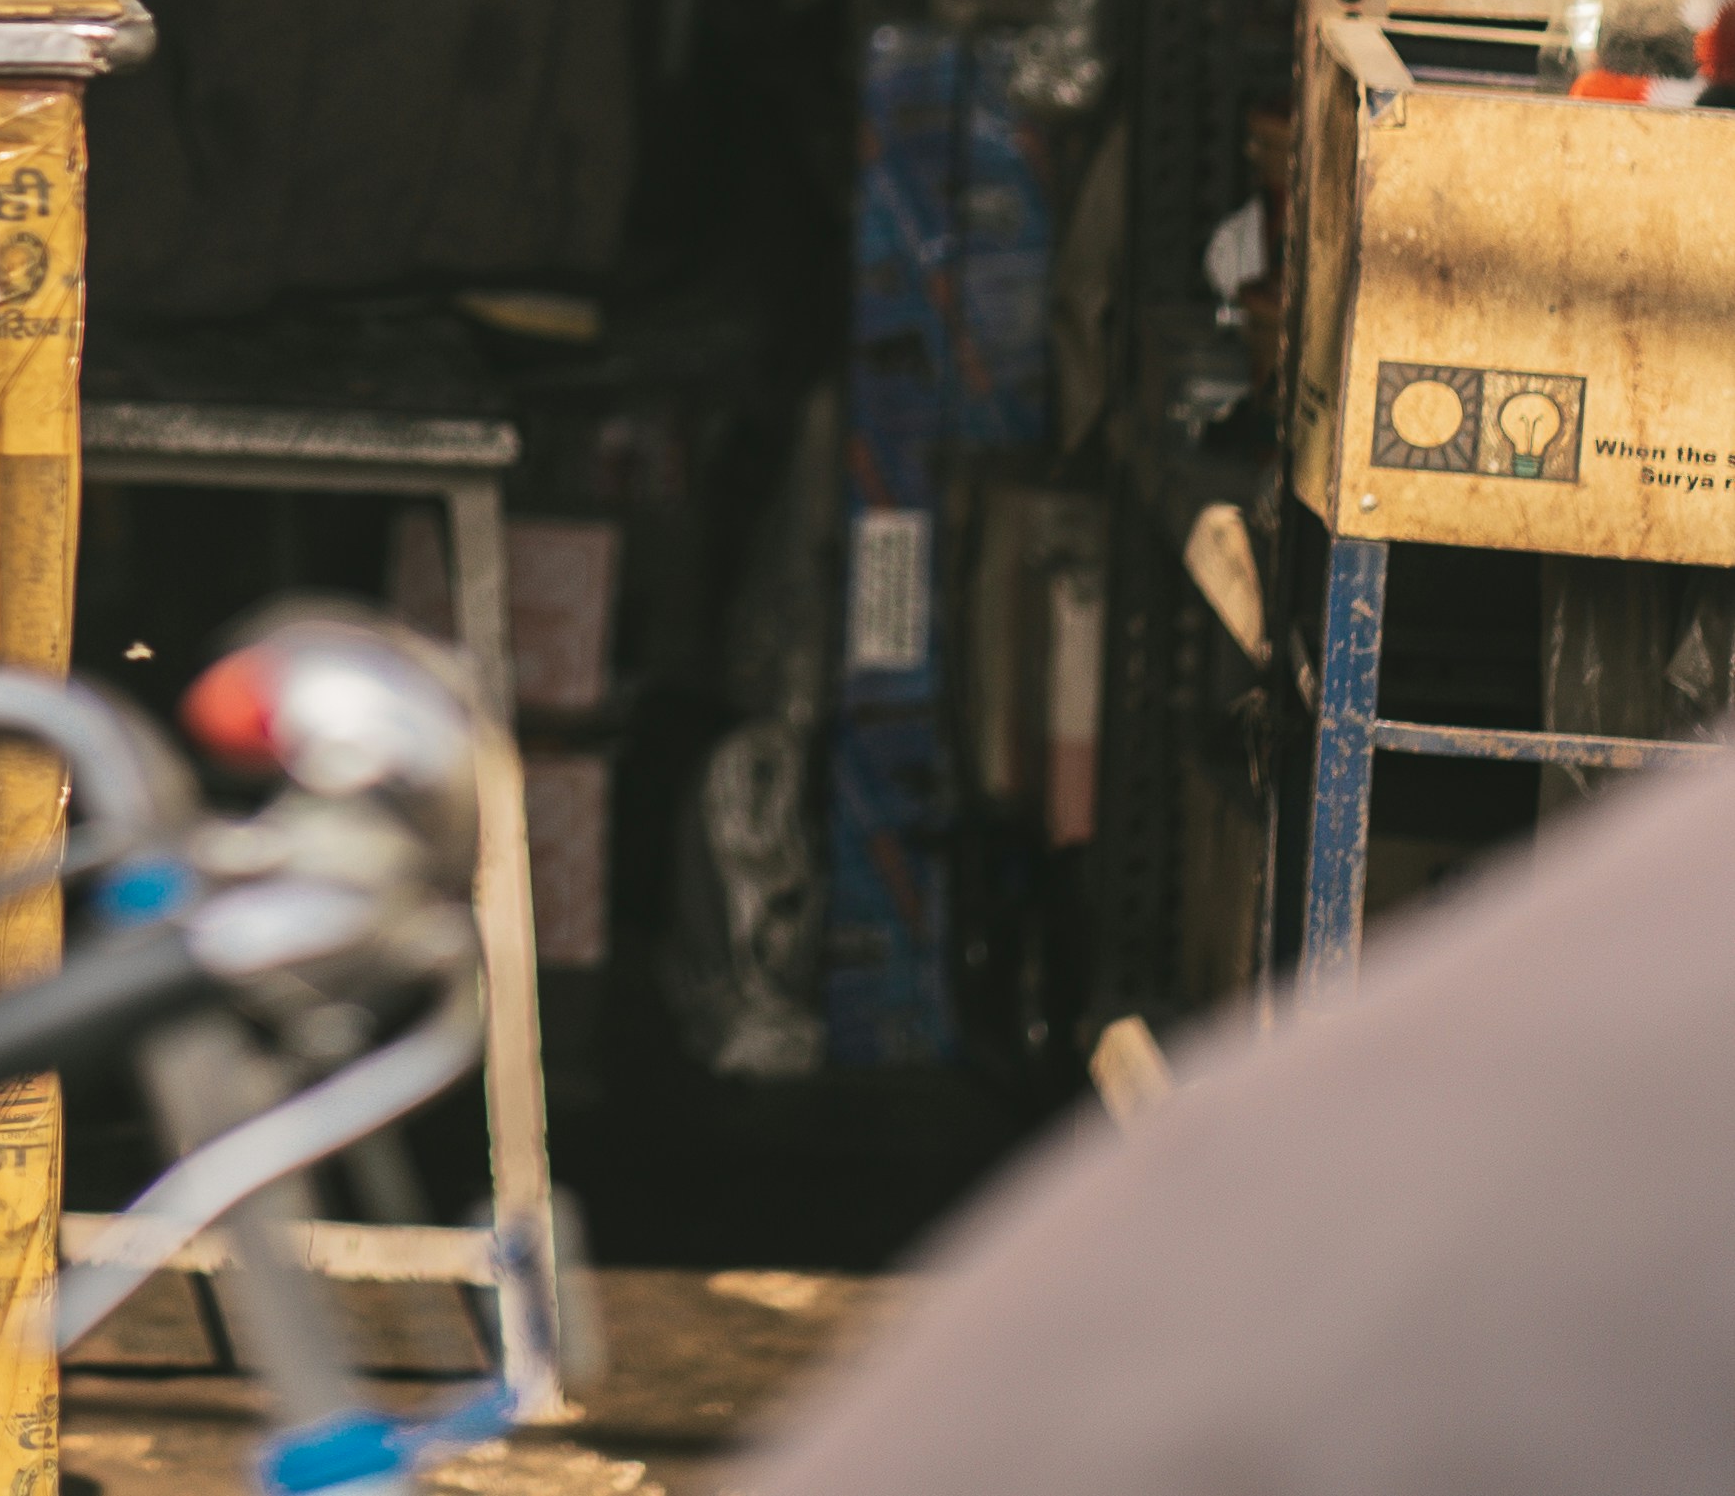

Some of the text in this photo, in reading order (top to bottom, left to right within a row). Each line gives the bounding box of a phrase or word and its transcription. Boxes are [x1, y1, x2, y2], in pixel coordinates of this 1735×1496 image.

[1595, 438, 1666, 461] When
[1677, 446, 1716, 464] the
[1642, 466, 1714, 491] Surya
